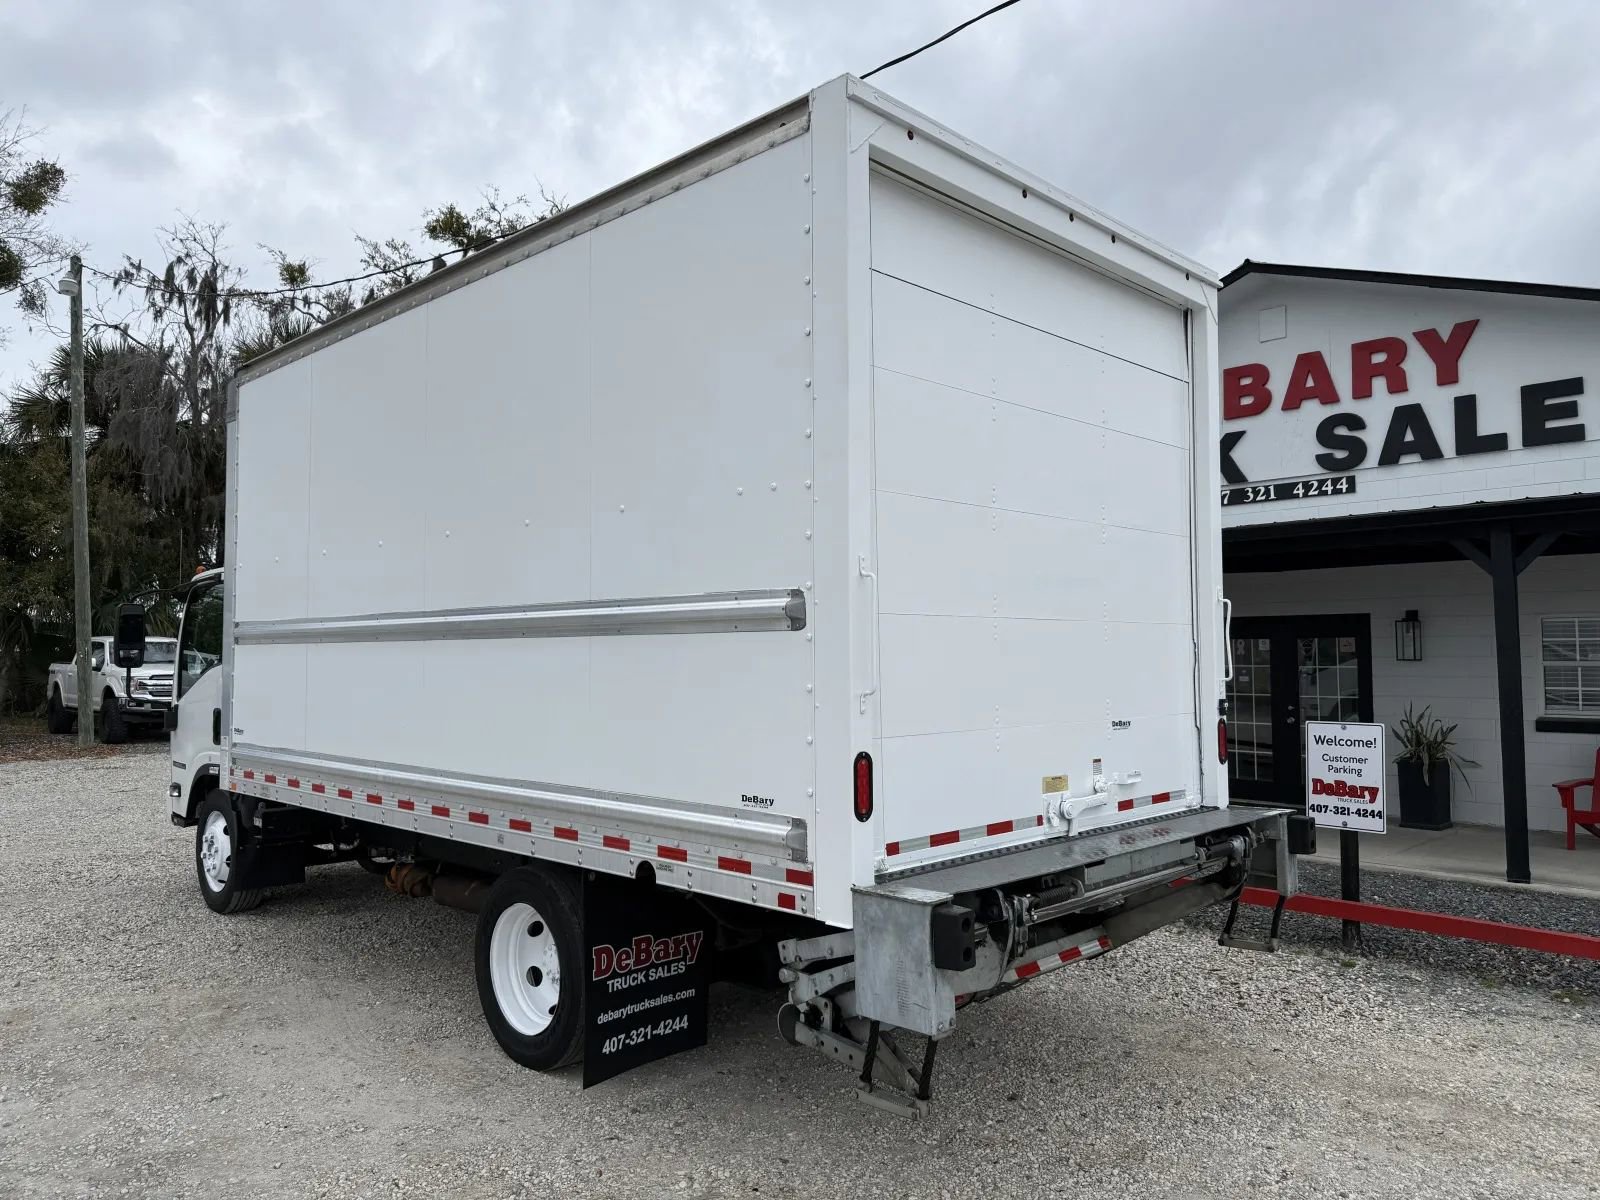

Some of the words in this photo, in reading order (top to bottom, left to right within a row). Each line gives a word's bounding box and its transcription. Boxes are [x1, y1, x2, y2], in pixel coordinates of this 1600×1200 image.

[1314, 376, 1586, 472] SALE
[1243, 484, 1277, 503] 321
[1292, 476, 1349, 498] 4244
[1313, 734, 1377, 749] Welcome!
[1321, 753, 1369, 765] Customer
[1327, 764, 1363, 778] Parking
[741, 794, 775, 807] DeBary
[1311, 777, 1380, 804] DeBary
[1309, 803, 1383, 820] 407-321-4244
[592, 930, 704, 982] DeBary
[606, 970, 647, 993] TRUCK
[648, 961, 687, 981] SALES
[597, 988, 696, 1025] debarytrucksales.com
[602, 1014, 689, 1055] 407-321-4244
